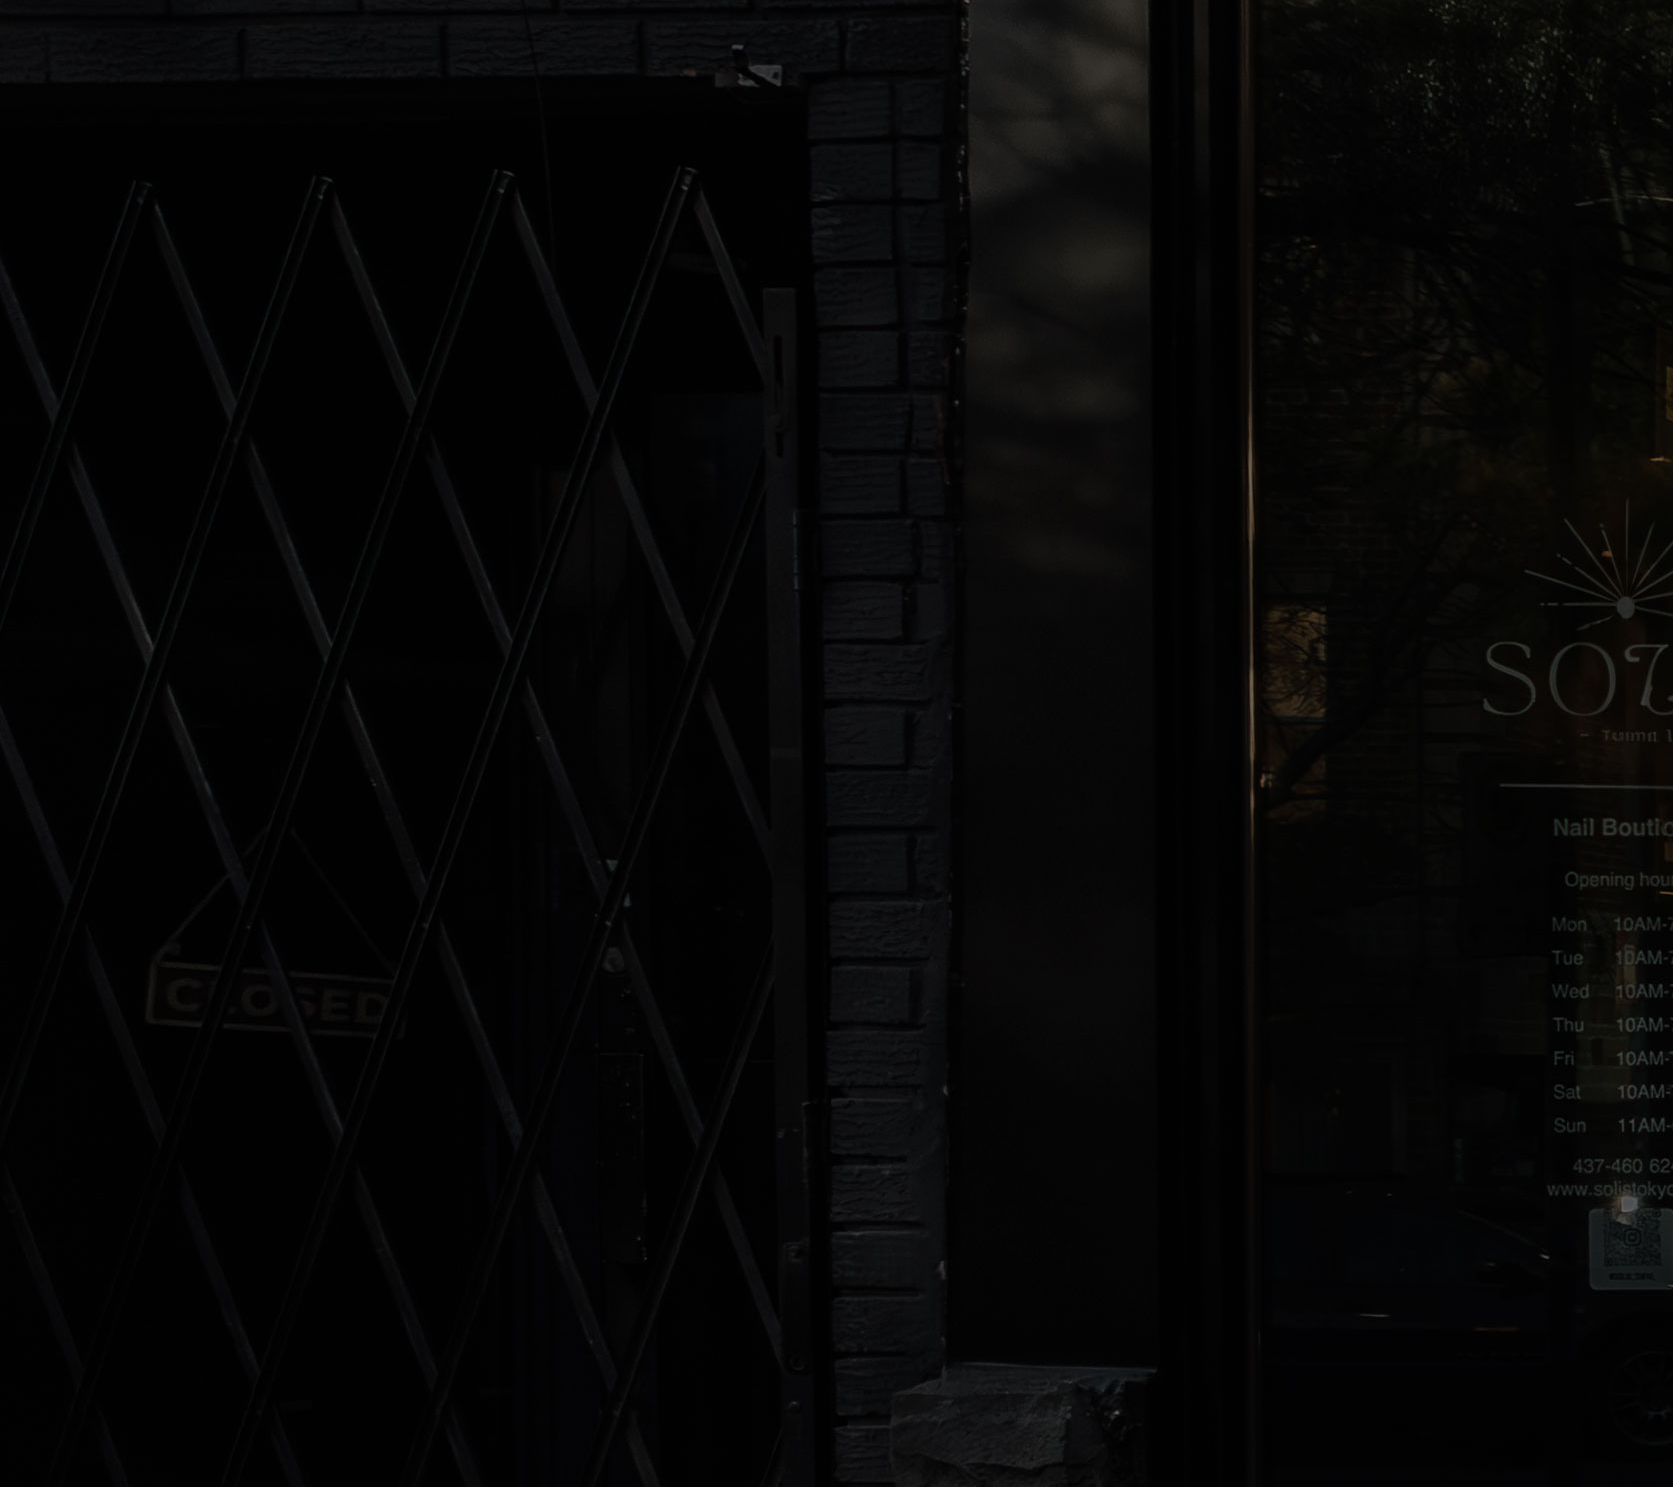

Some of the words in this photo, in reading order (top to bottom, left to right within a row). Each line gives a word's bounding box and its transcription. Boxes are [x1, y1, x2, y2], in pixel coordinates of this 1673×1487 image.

[1553, 818, 1595, 838] Nail
[1564, 872, 1635, 892] Opening
[1552, 917, 1587, 933] Mon
[1552, 951, 1584, 967] Tue
[1552, 985, 1590, 1000] Wed
[1553, 1017, 1585, 1034] Thu
[1554, 1051, 1575, 1067] Fri
[1553, 1084, 1582, 1101] Sat
[1554, 1118, 1587, 1134] Sun
[1573, 1158, 1643, 1175] 437-460
